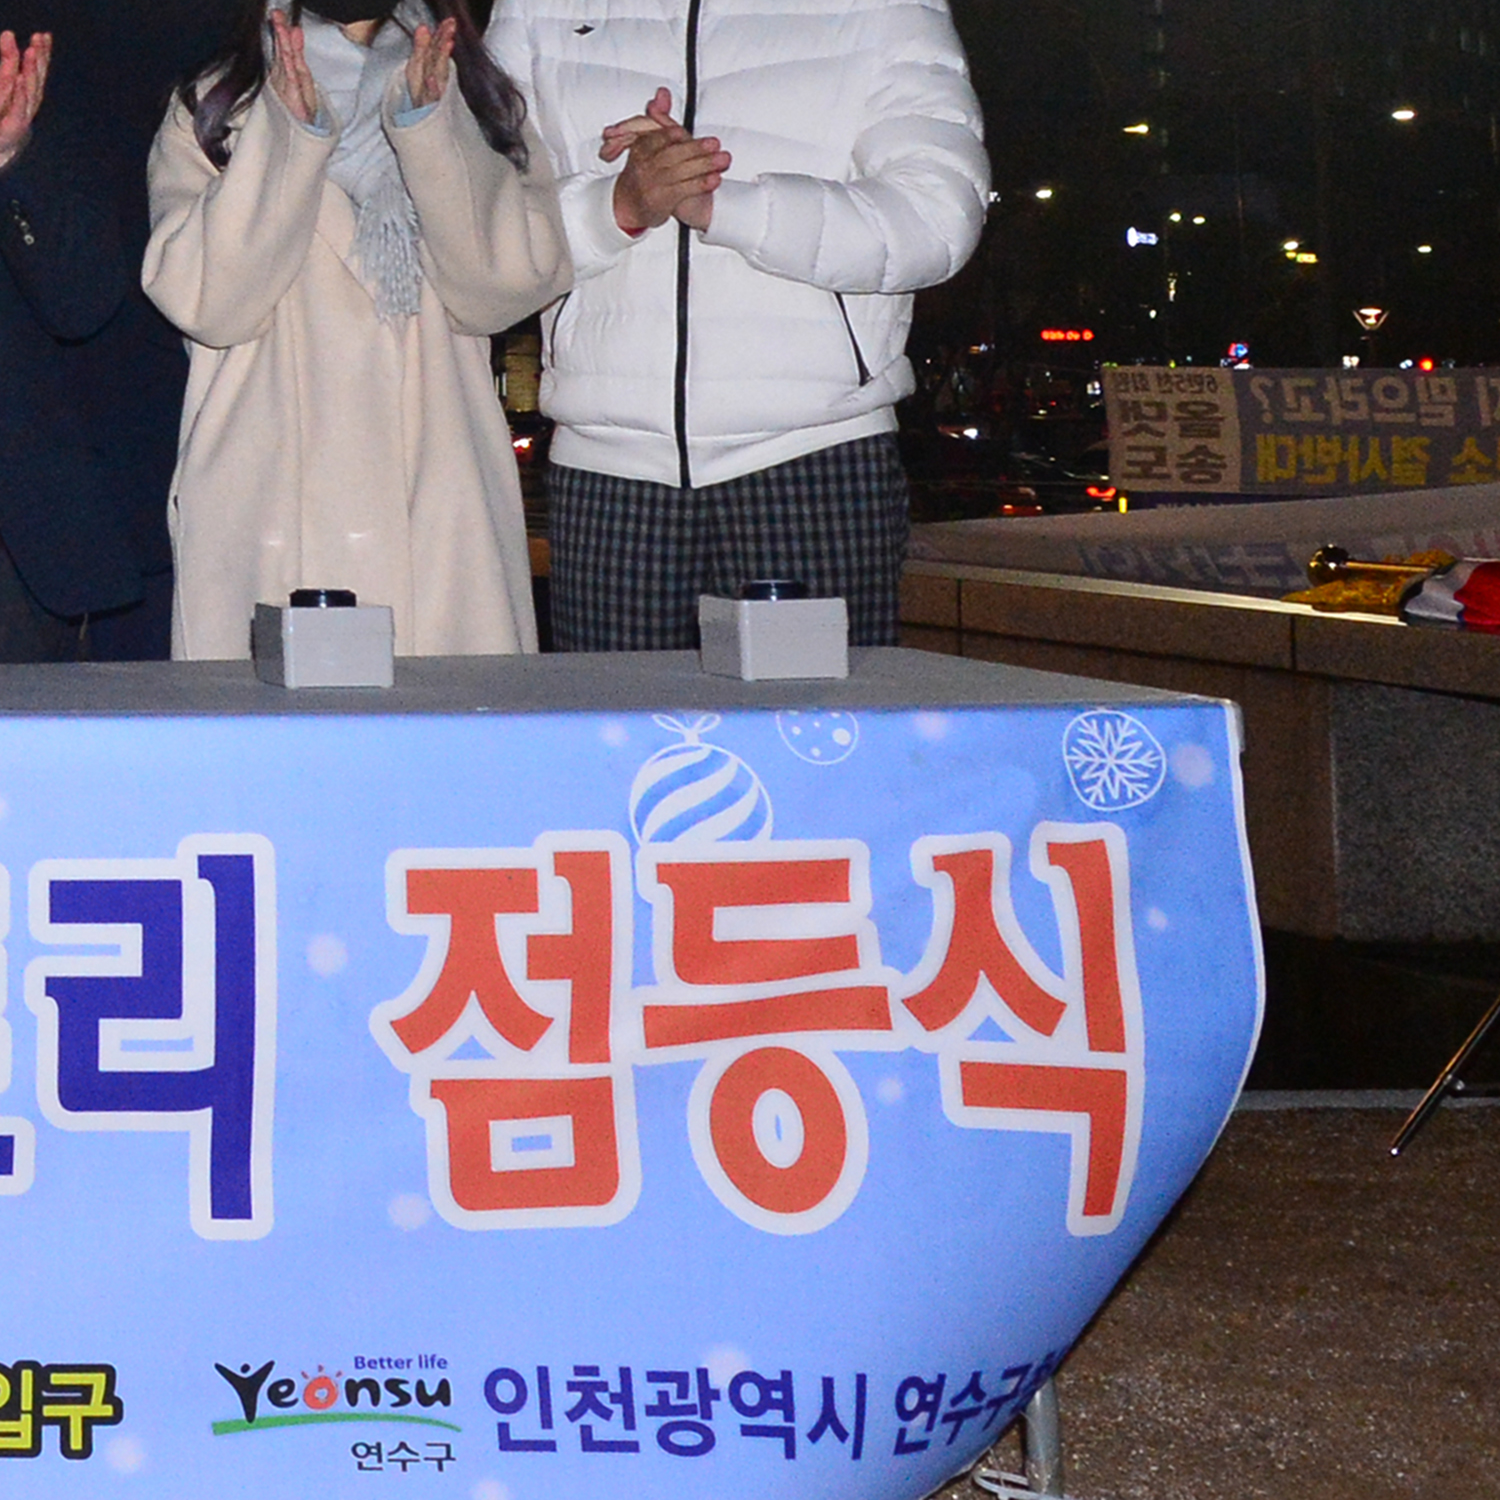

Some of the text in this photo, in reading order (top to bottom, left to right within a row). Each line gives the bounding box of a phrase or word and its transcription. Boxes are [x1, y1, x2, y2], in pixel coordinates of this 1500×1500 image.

[385, 835, 1131, 1222] 점등식
[214, 1360, 452, 1424] Yeonsu
[353, 1353, 448, 1370] Better life
[482, 1363, 868, 1462] 인천광역시
[350, 1440, 457, 1473] 연수구
